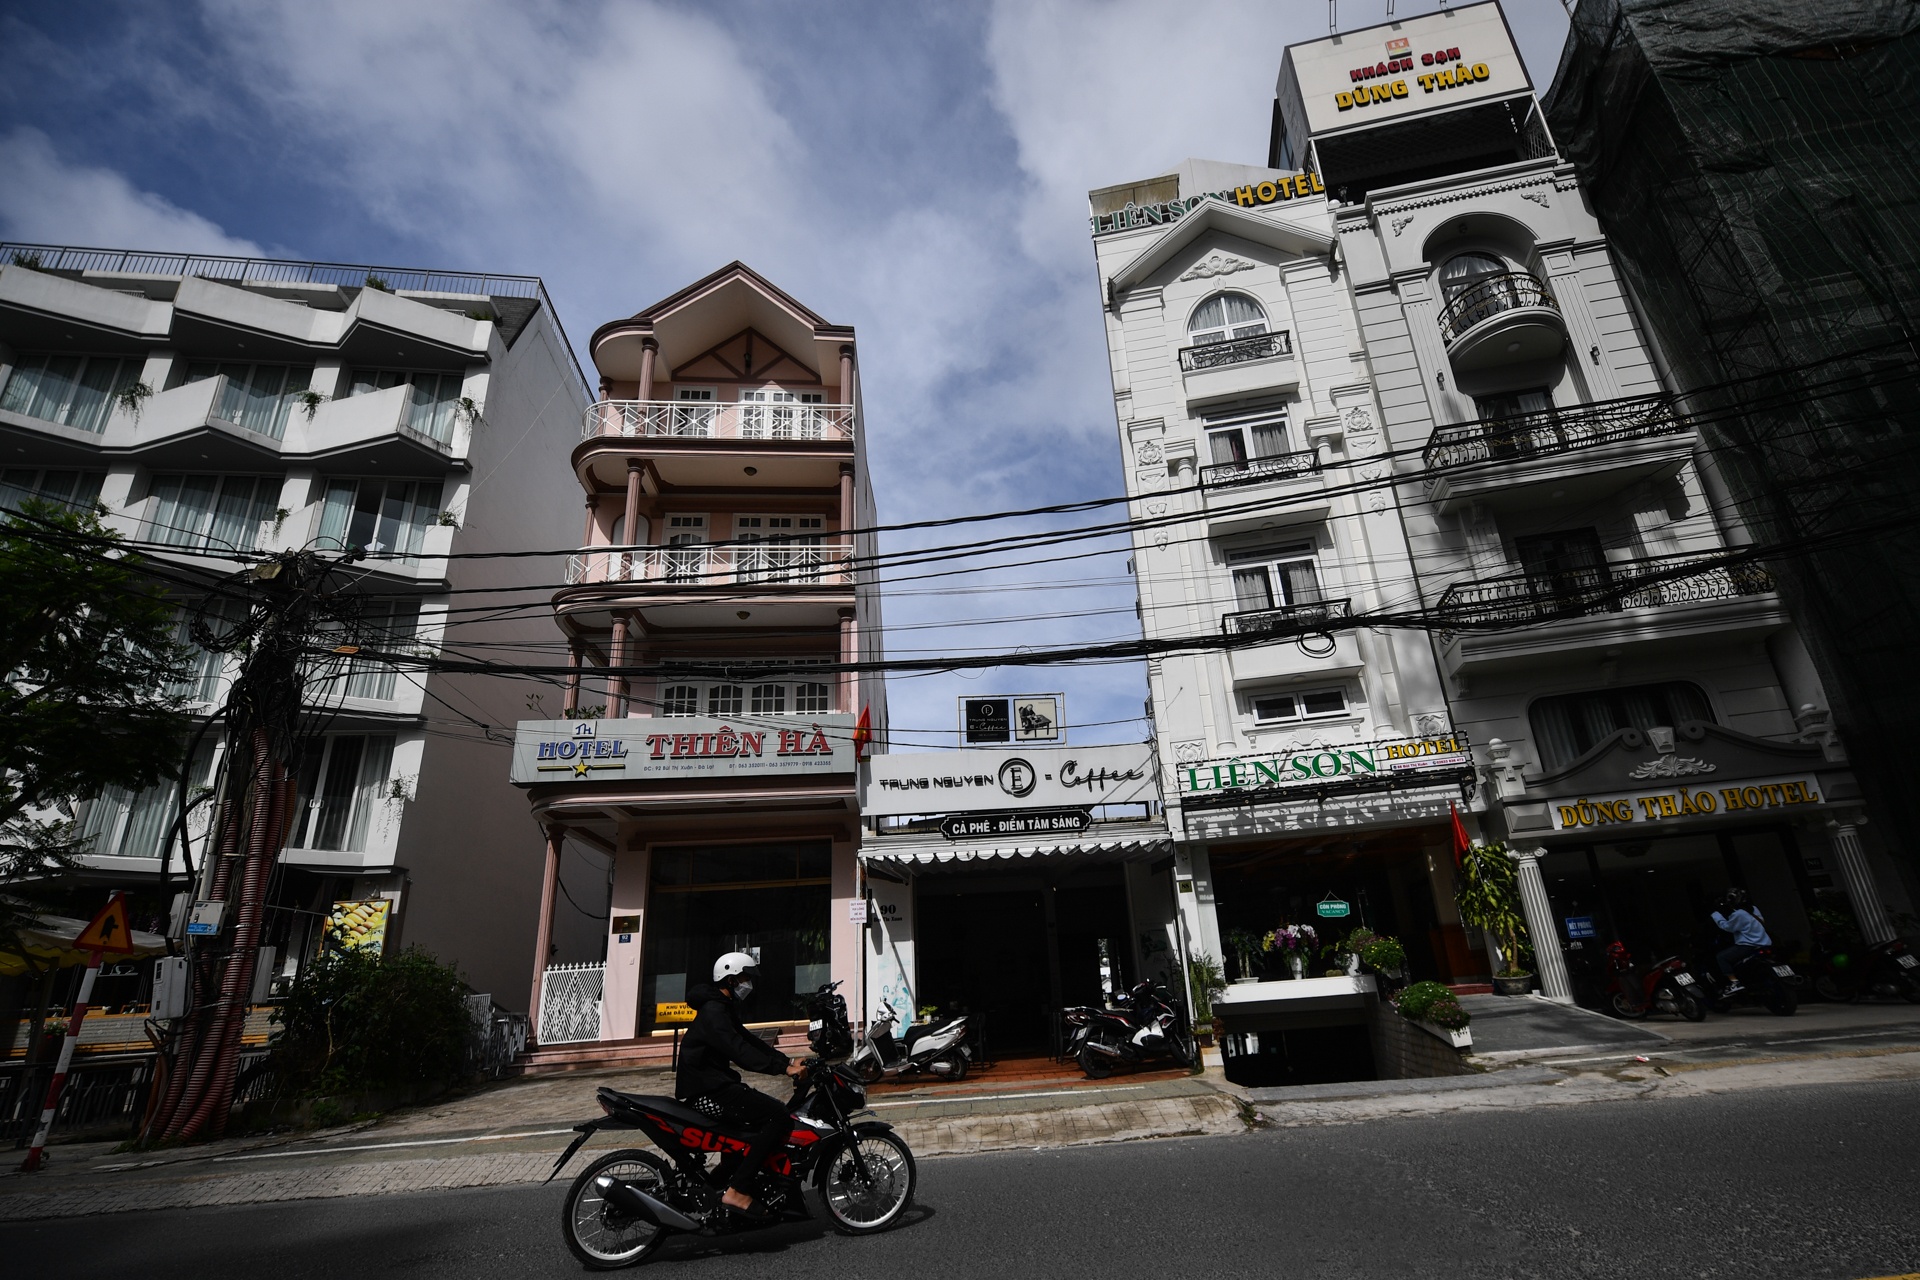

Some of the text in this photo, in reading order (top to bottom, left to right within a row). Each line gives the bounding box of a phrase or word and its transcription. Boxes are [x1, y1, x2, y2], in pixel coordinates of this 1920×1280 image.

[1350, 47, 1461, 81] KHÁCH SẠN
[1335, 63, 1490, 110] DŨNG THẢO
[1092, 201, 1163, 233] LIÊN
[1235, 172, 1324, 207] HOTEL
[537, 722, 832, 759] HOTEL THIÊN HÀ
[879, 778, 929, 791] TRUNG
[932, 775, 994, 788] NGUYEN
[1010, 767, 1023, 790] E
[1060, 760, 1144, 792] Coffee
[1188, 737, 1464, 792] LIÊN SƠN HOTEL
[1558, 781, 1818, 827] DŨNG THẢO HOTEL
[952, 820, 968, 835] CÀ
[969, 817, 990, 834] PHÊ
[998, 815, 1025, 832] ĐIỂM
[1027, 816, 1050, 831] TÂM
[1052, 814, 1080, 830] SÁNG
[880, 904, 896, 914] 90
